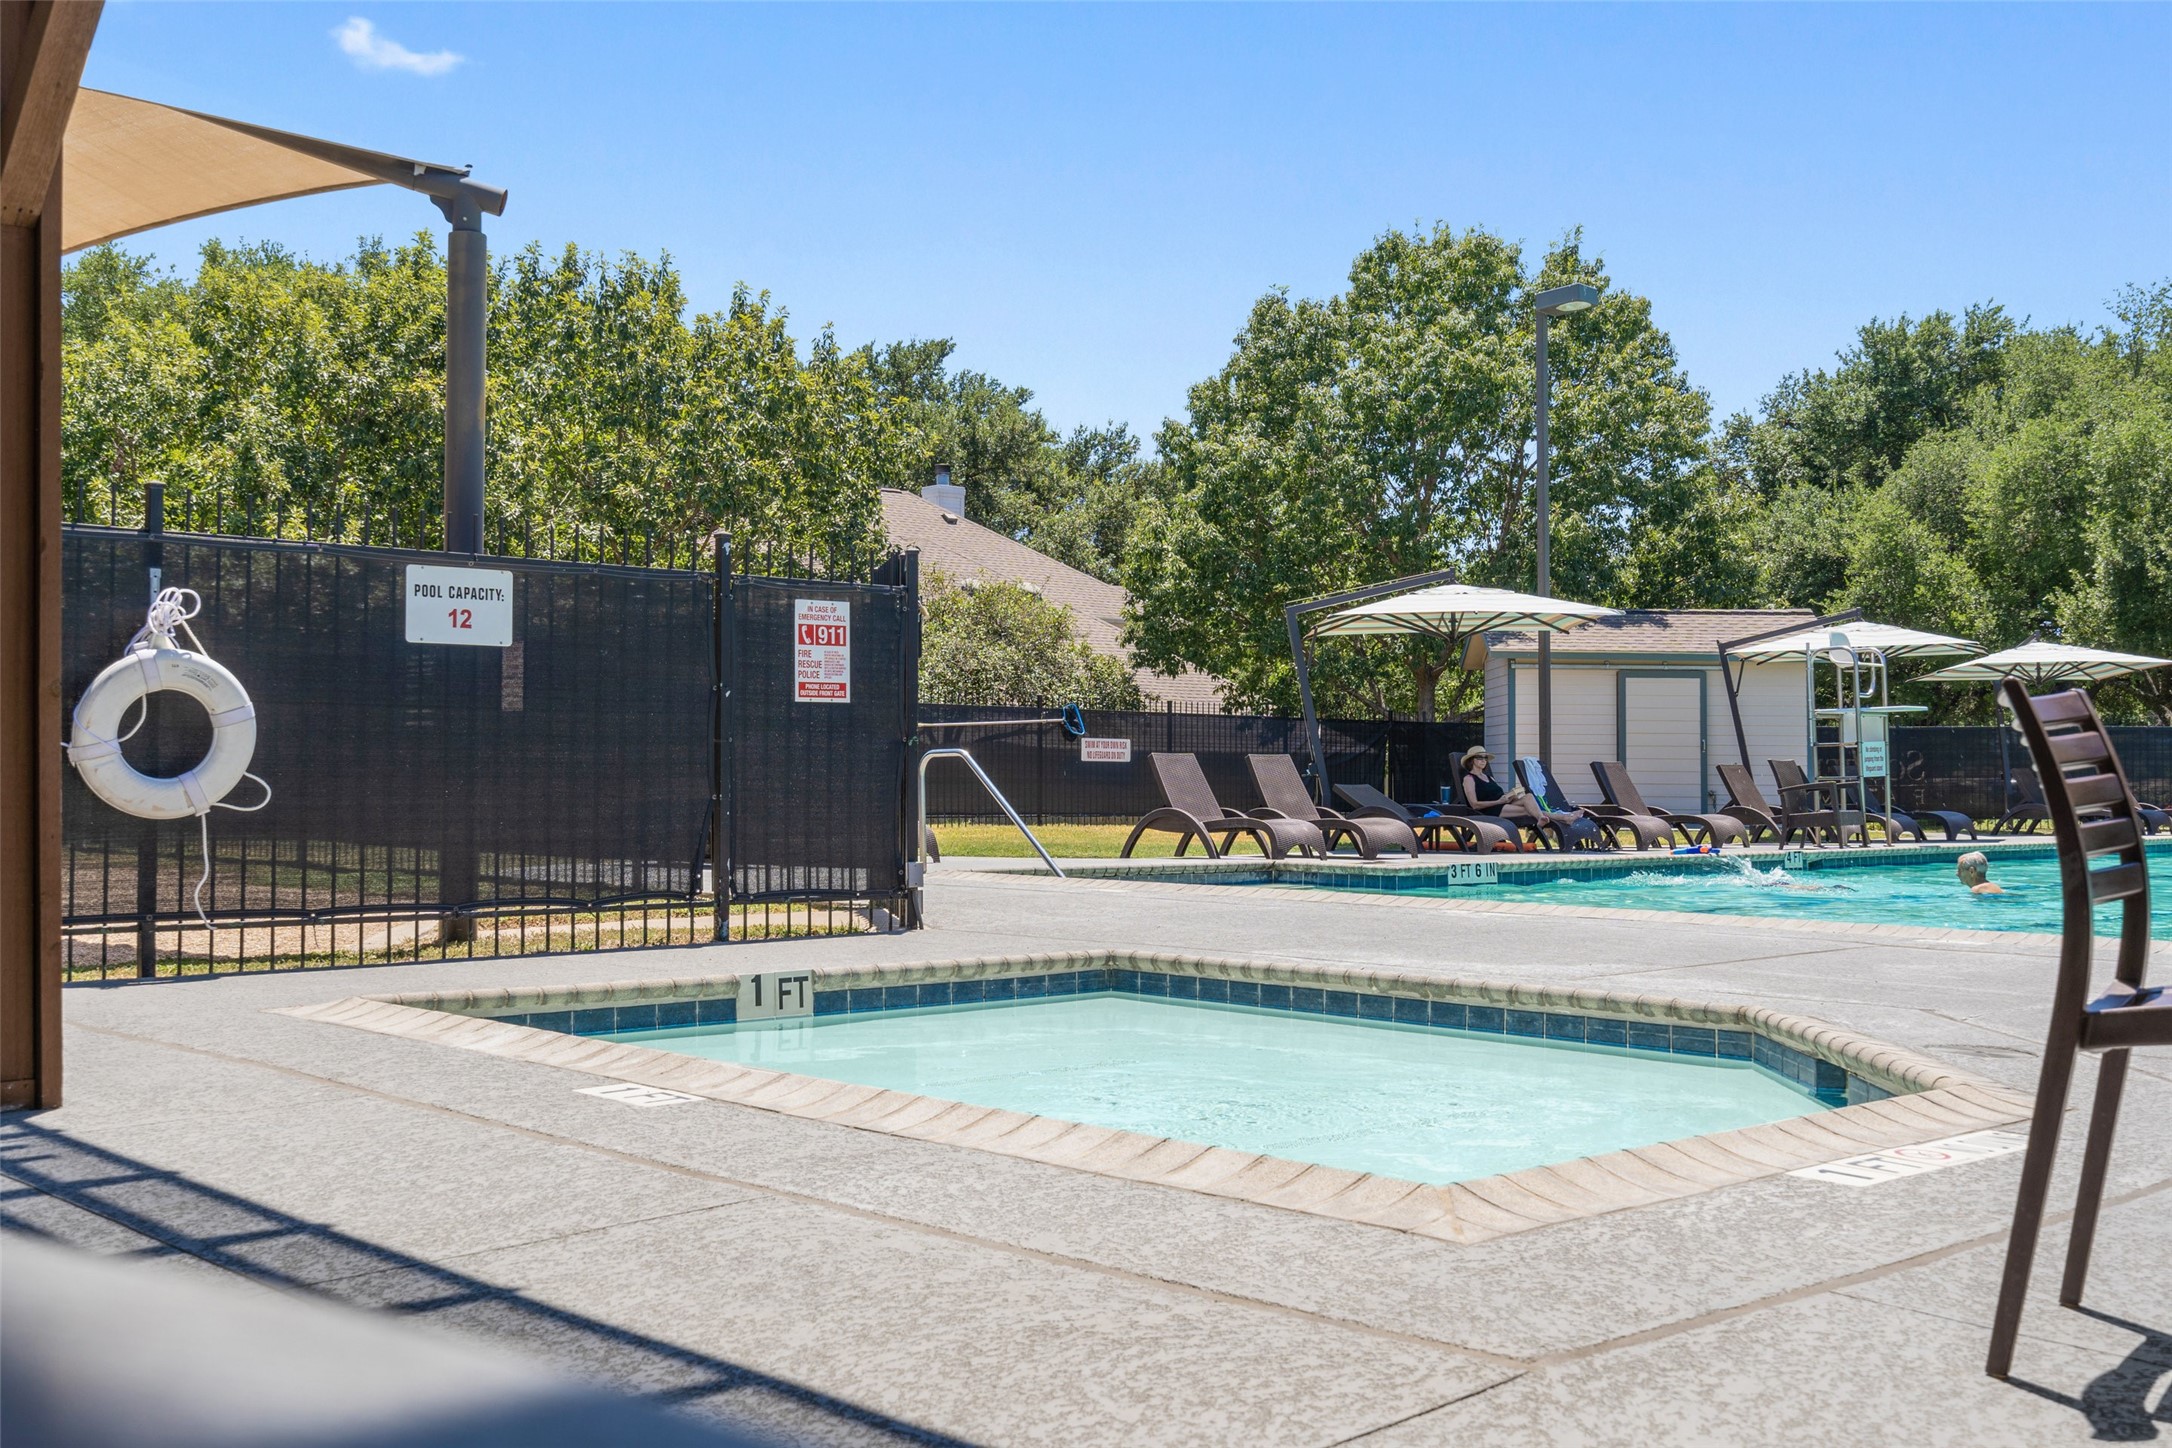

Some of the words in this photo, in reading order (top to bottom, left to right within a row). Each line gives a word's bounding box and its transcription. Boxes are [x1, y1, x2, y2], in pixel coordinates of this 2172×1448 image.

[414, 584, 443, 599] POOL
[448, 585, 505, 602] CAPACITY:
[807, 605, 813, 613] IN
[448, 608, 473, 629] 12
[798, 613, 832, 621] EMERGENCY
[817, 626, 844, 645] 911
[798, 649, 812, 658] FIRE
[798, 660, 822, 669] RESCUE
[798, 670, 820, 679] POLICE
[1793, 851, 1801, 863] FT
[1451, 864, 1457, 878] 3
[1460, 863, 1471, 878] FT
[1475, 863, 1482, 877] 6
[1485, 862, 1496, 877] IN
[751, 974, 762, 1007] 1
[778, 975, 809, 1010] FT
[623, 1091, 691, 1104] FT
[1817, 1168, 1874, 1180] 1
[1846, 1156, 1923, 1174] FT
